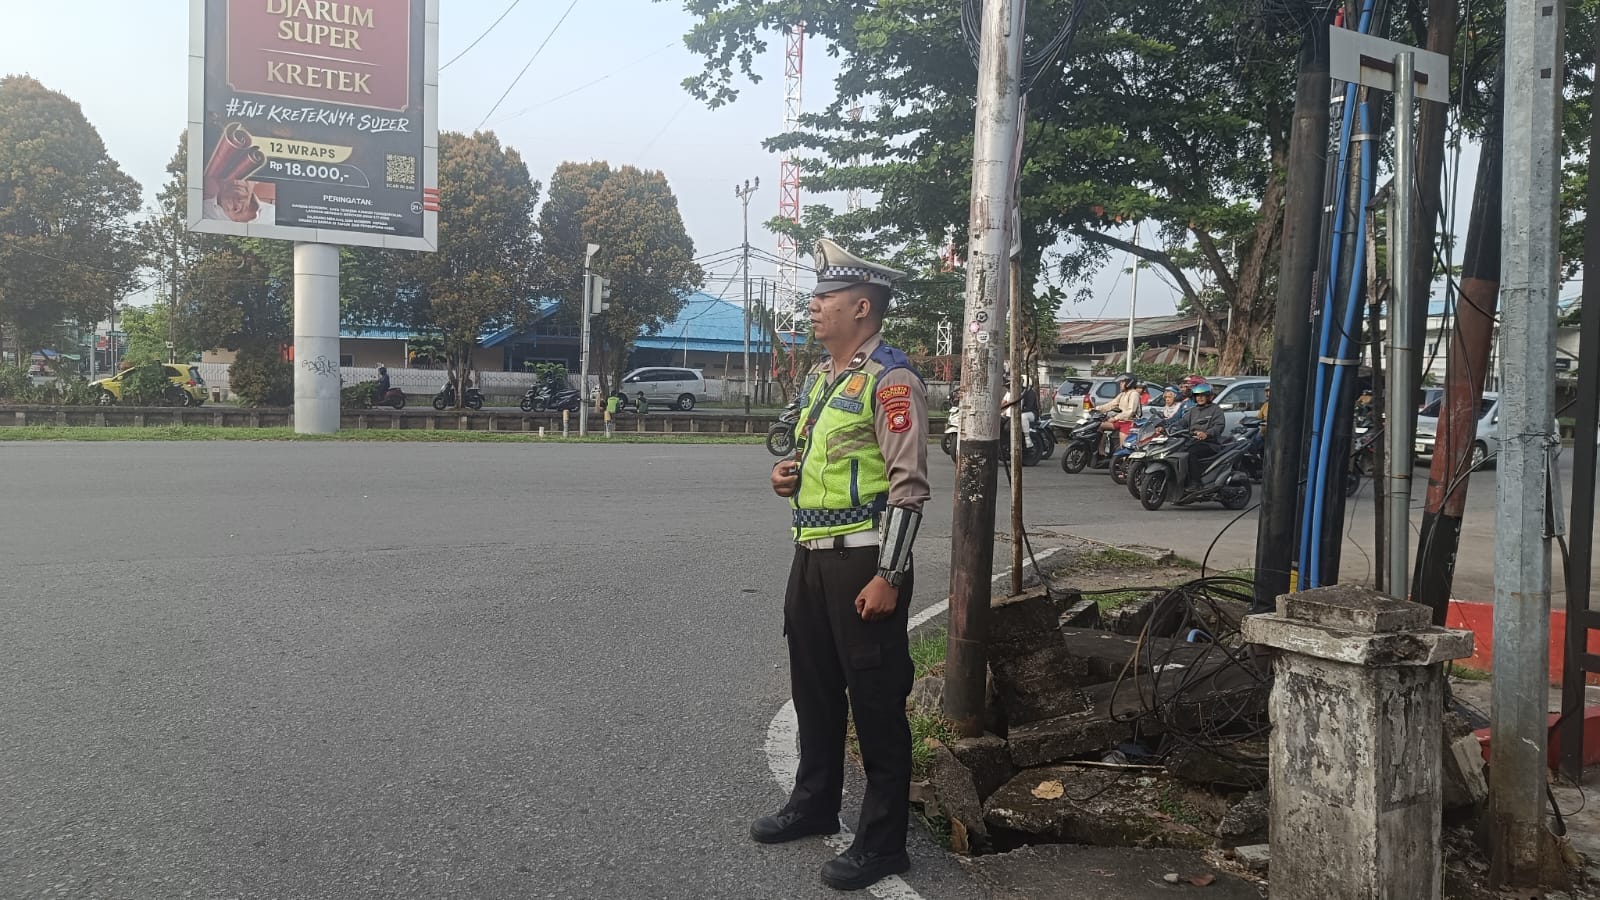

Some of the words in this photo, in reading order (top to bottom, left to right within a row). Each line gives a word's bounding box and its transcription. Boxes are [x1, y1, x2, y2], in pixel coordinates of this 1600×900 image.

[265, 0, 374, 28] DJARUM
[278, 20, 362, 50] SUPER
[266, 62, 371, 94] KRETEK
[269, 142, 283, 153] 12
[287, 143, 336, 159] WRAPS
[269, 161, 283, 171] Rp
[285, 162, 349, 182] 18.000,-
